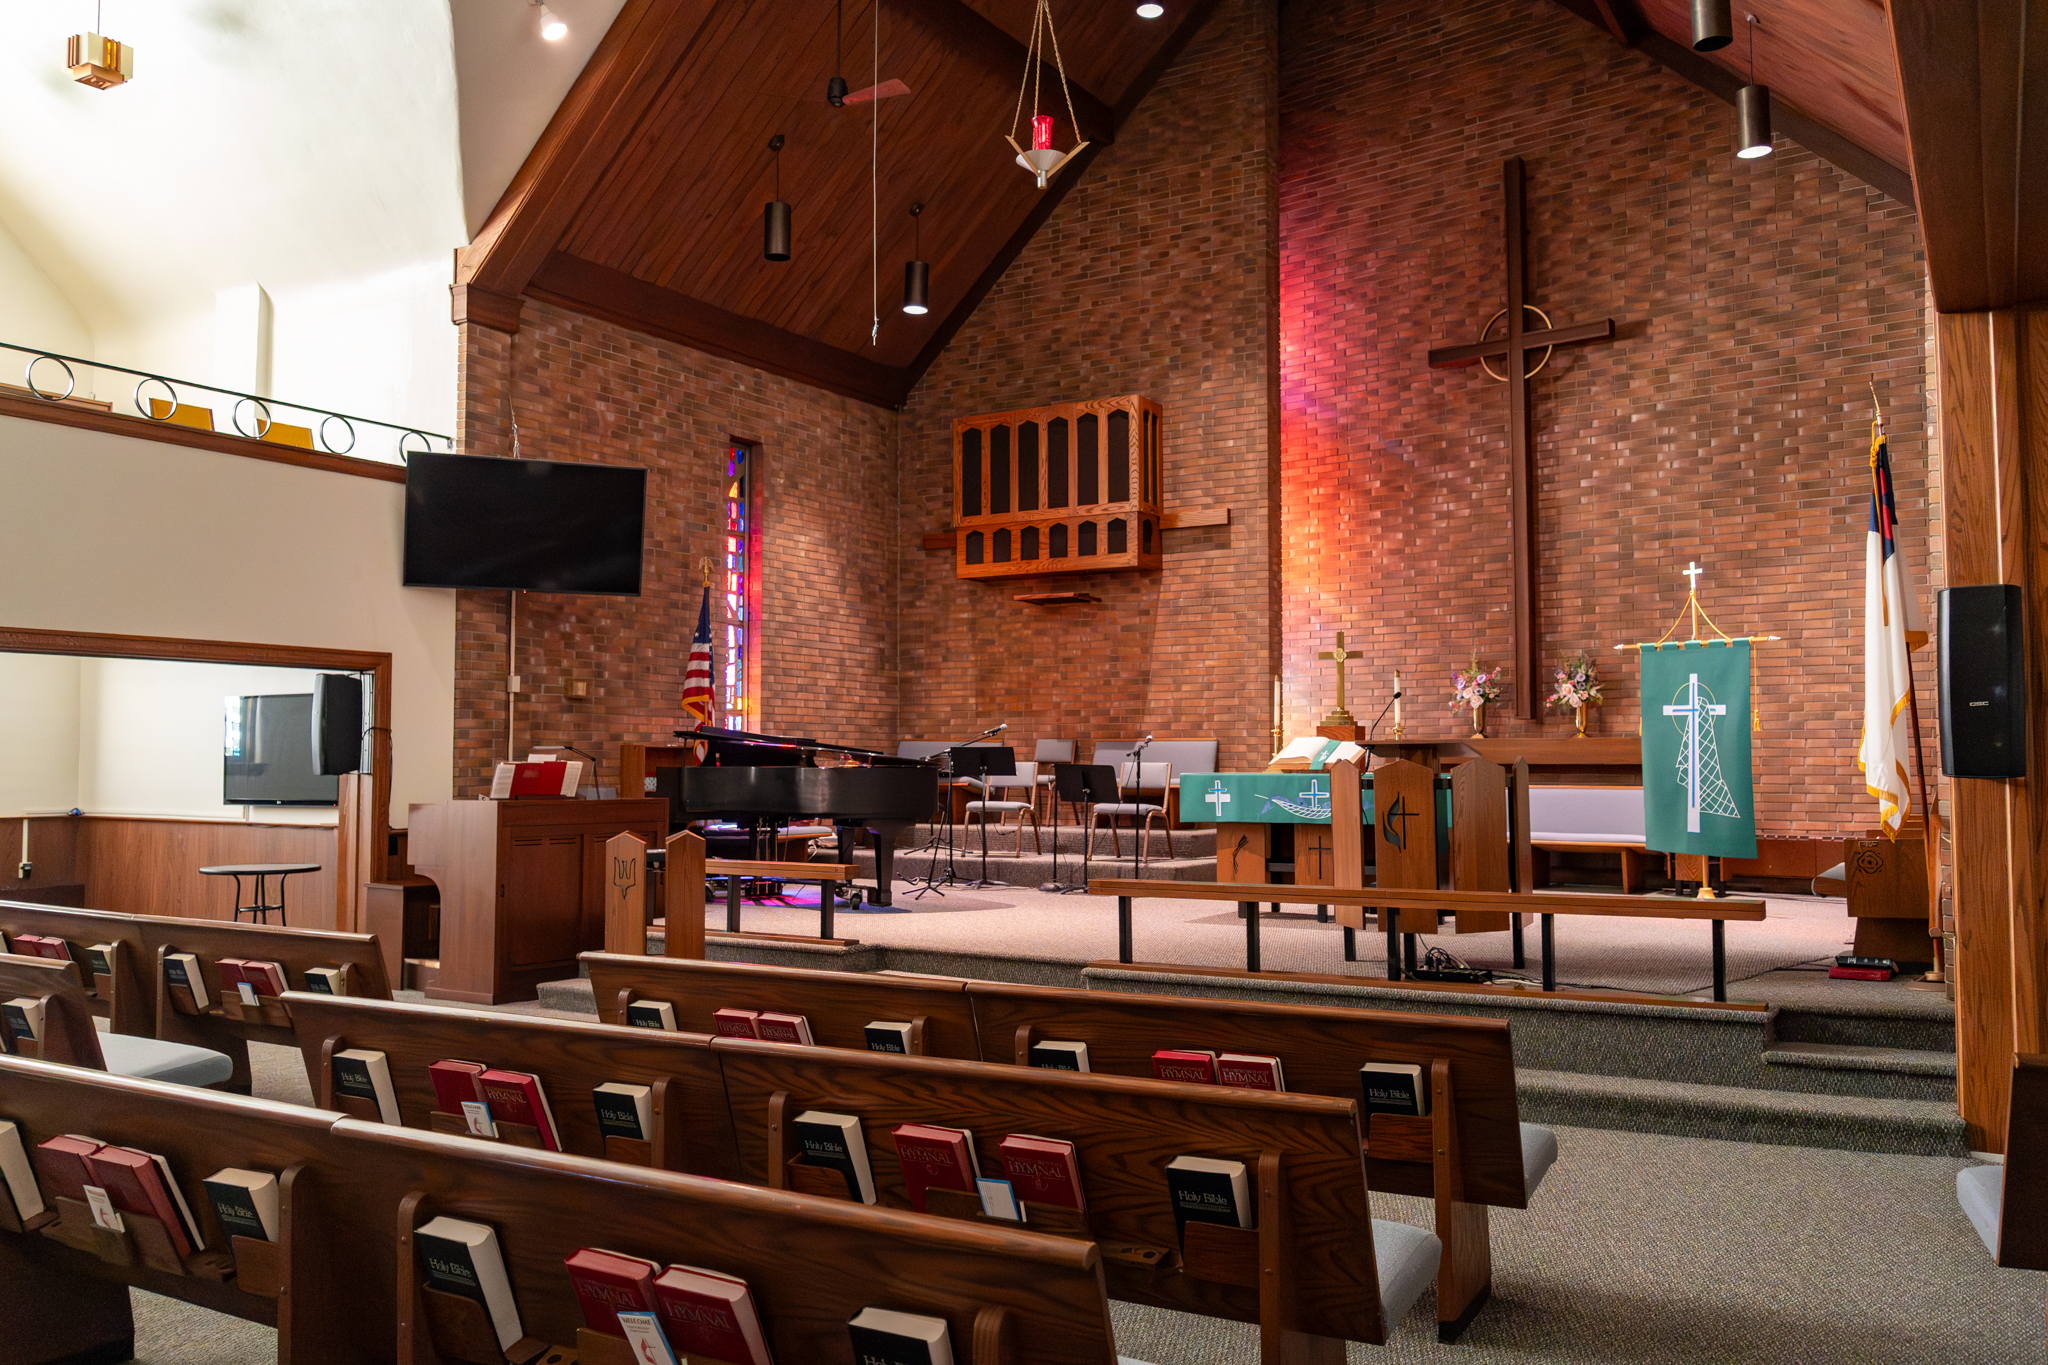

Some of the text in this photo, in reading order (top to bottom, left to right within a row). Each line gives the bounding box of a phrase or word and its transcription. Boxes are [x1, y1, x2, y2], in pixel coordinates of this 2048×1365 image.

[871, 1042, 901, 1053] Holy Bible
[1160, 1068, 1208, 1080] HYMNAL
[1222, 1071, 1271, 1085] HYMNAL
[487, 1089, 527, 1104] HYMNAL
[1368, 1088, 1410, 1100] Holy Bible
[600, 1108, 634, 1122] Holy Bible
[804, 1139, 843, 1153] Holy Bible
[900, 1147, 954, 1165] HYMNAL
[1008, 1160, 1066, 1179] HYMNAL
[1178, 1189, 1228, 1205] Holy Bible
[217, 1202, 256, 1219] Holy Bible
[429, 1257, 472, 1278] Holy Bible
[577, 1281, 640, 1309] HYMNAL
[621, 1316, 652, 1326] WELCOME
[664, 1301, 735, 1329] HYMNAL
